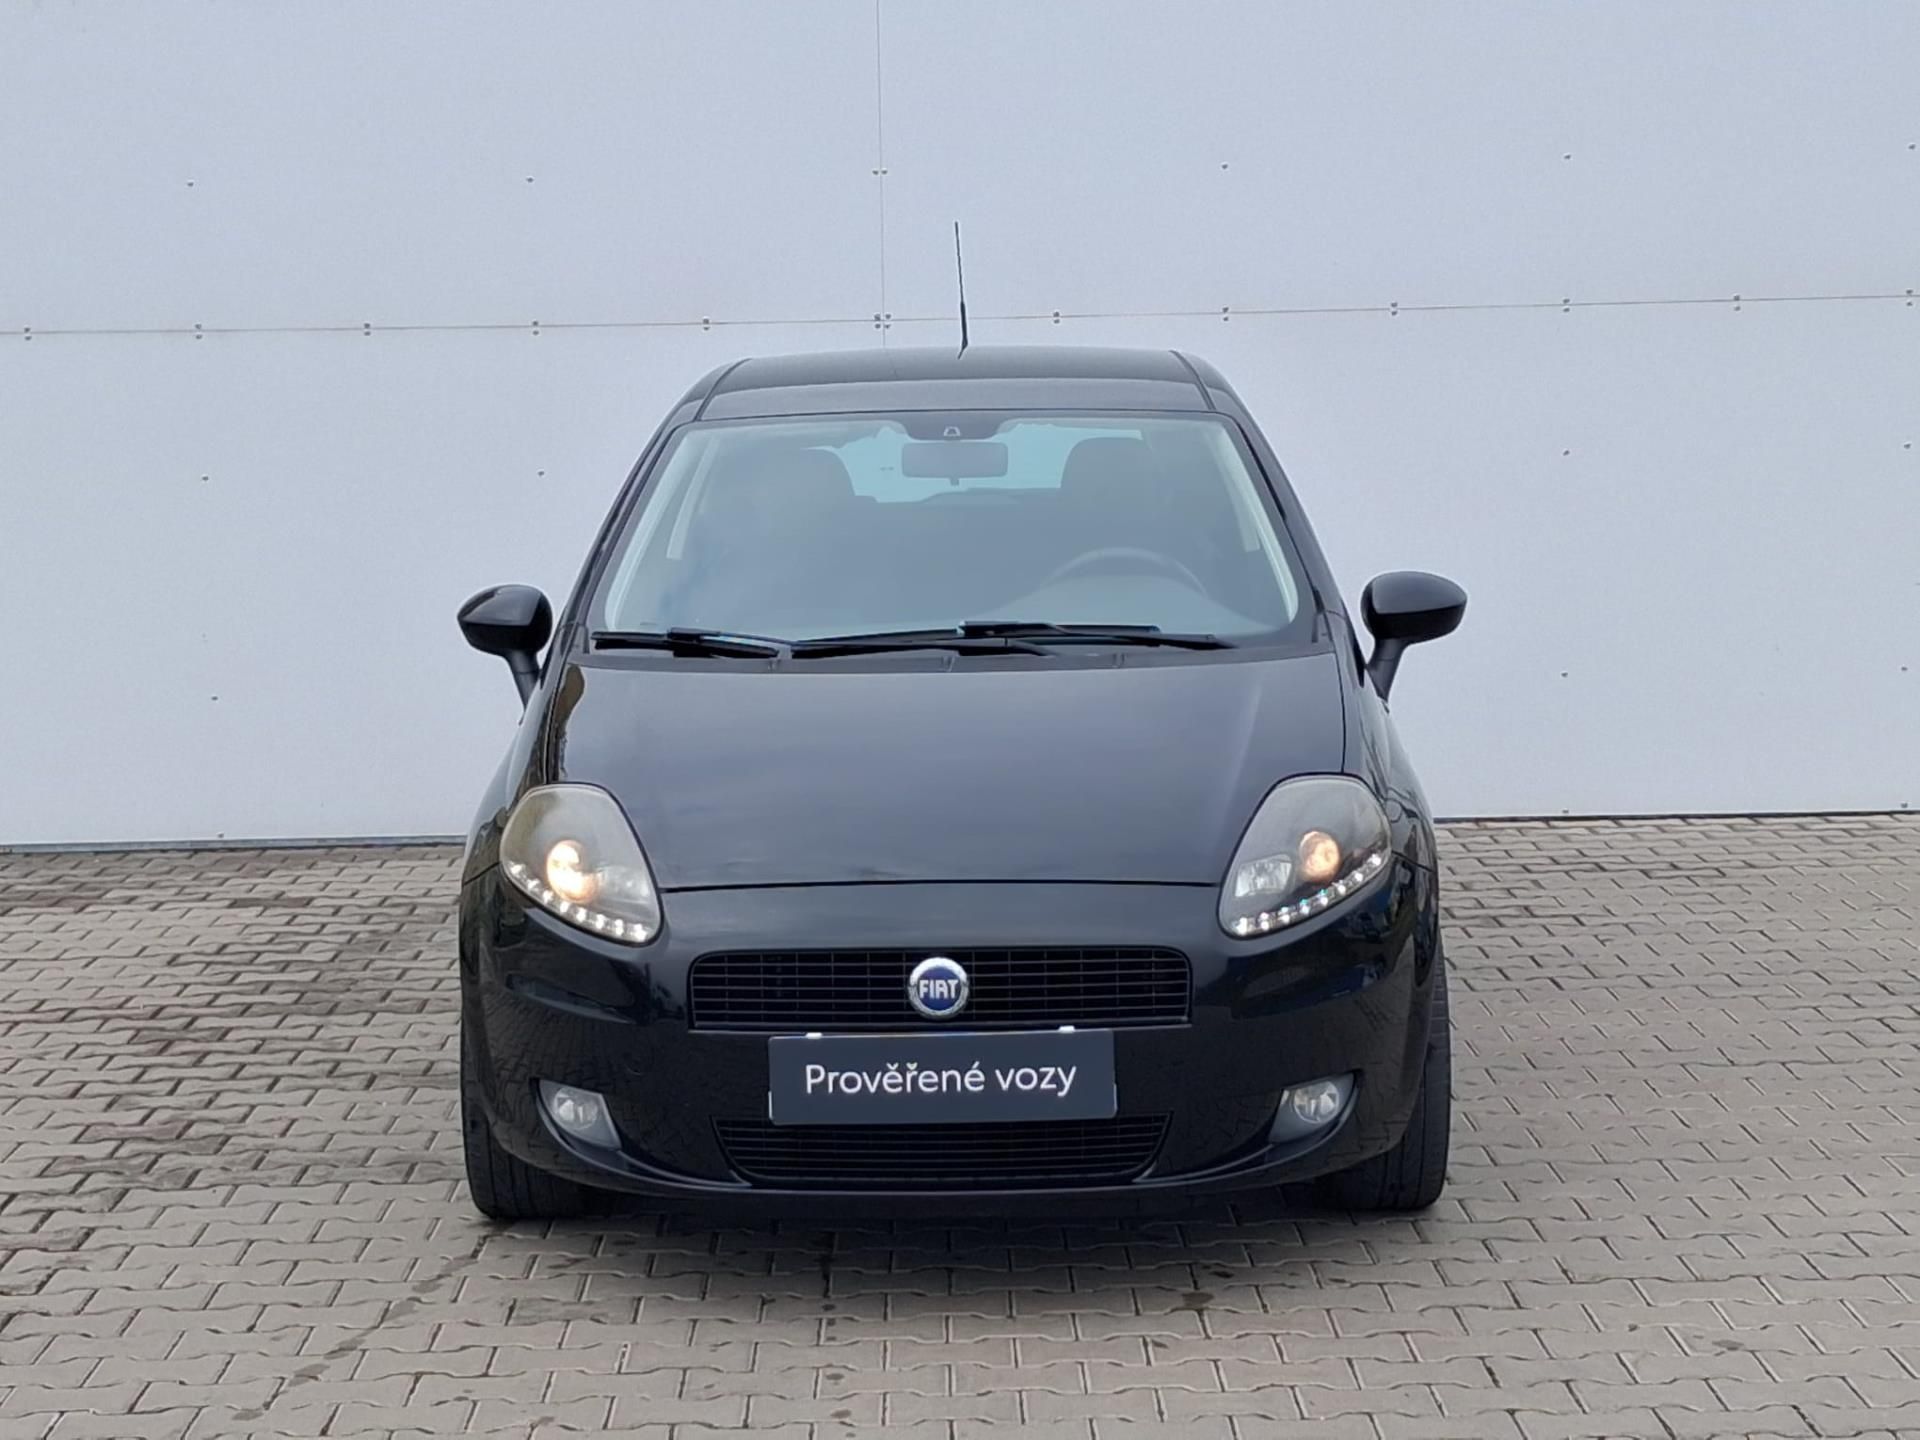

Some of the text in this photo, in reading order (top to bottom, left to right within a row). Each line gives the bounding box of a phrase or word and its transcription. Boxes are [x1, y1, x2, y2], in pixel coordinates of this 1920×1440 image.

[919, 979, 959, 999] FIAT
[805, 1062, 1077, 1098] Prověřené vozy
